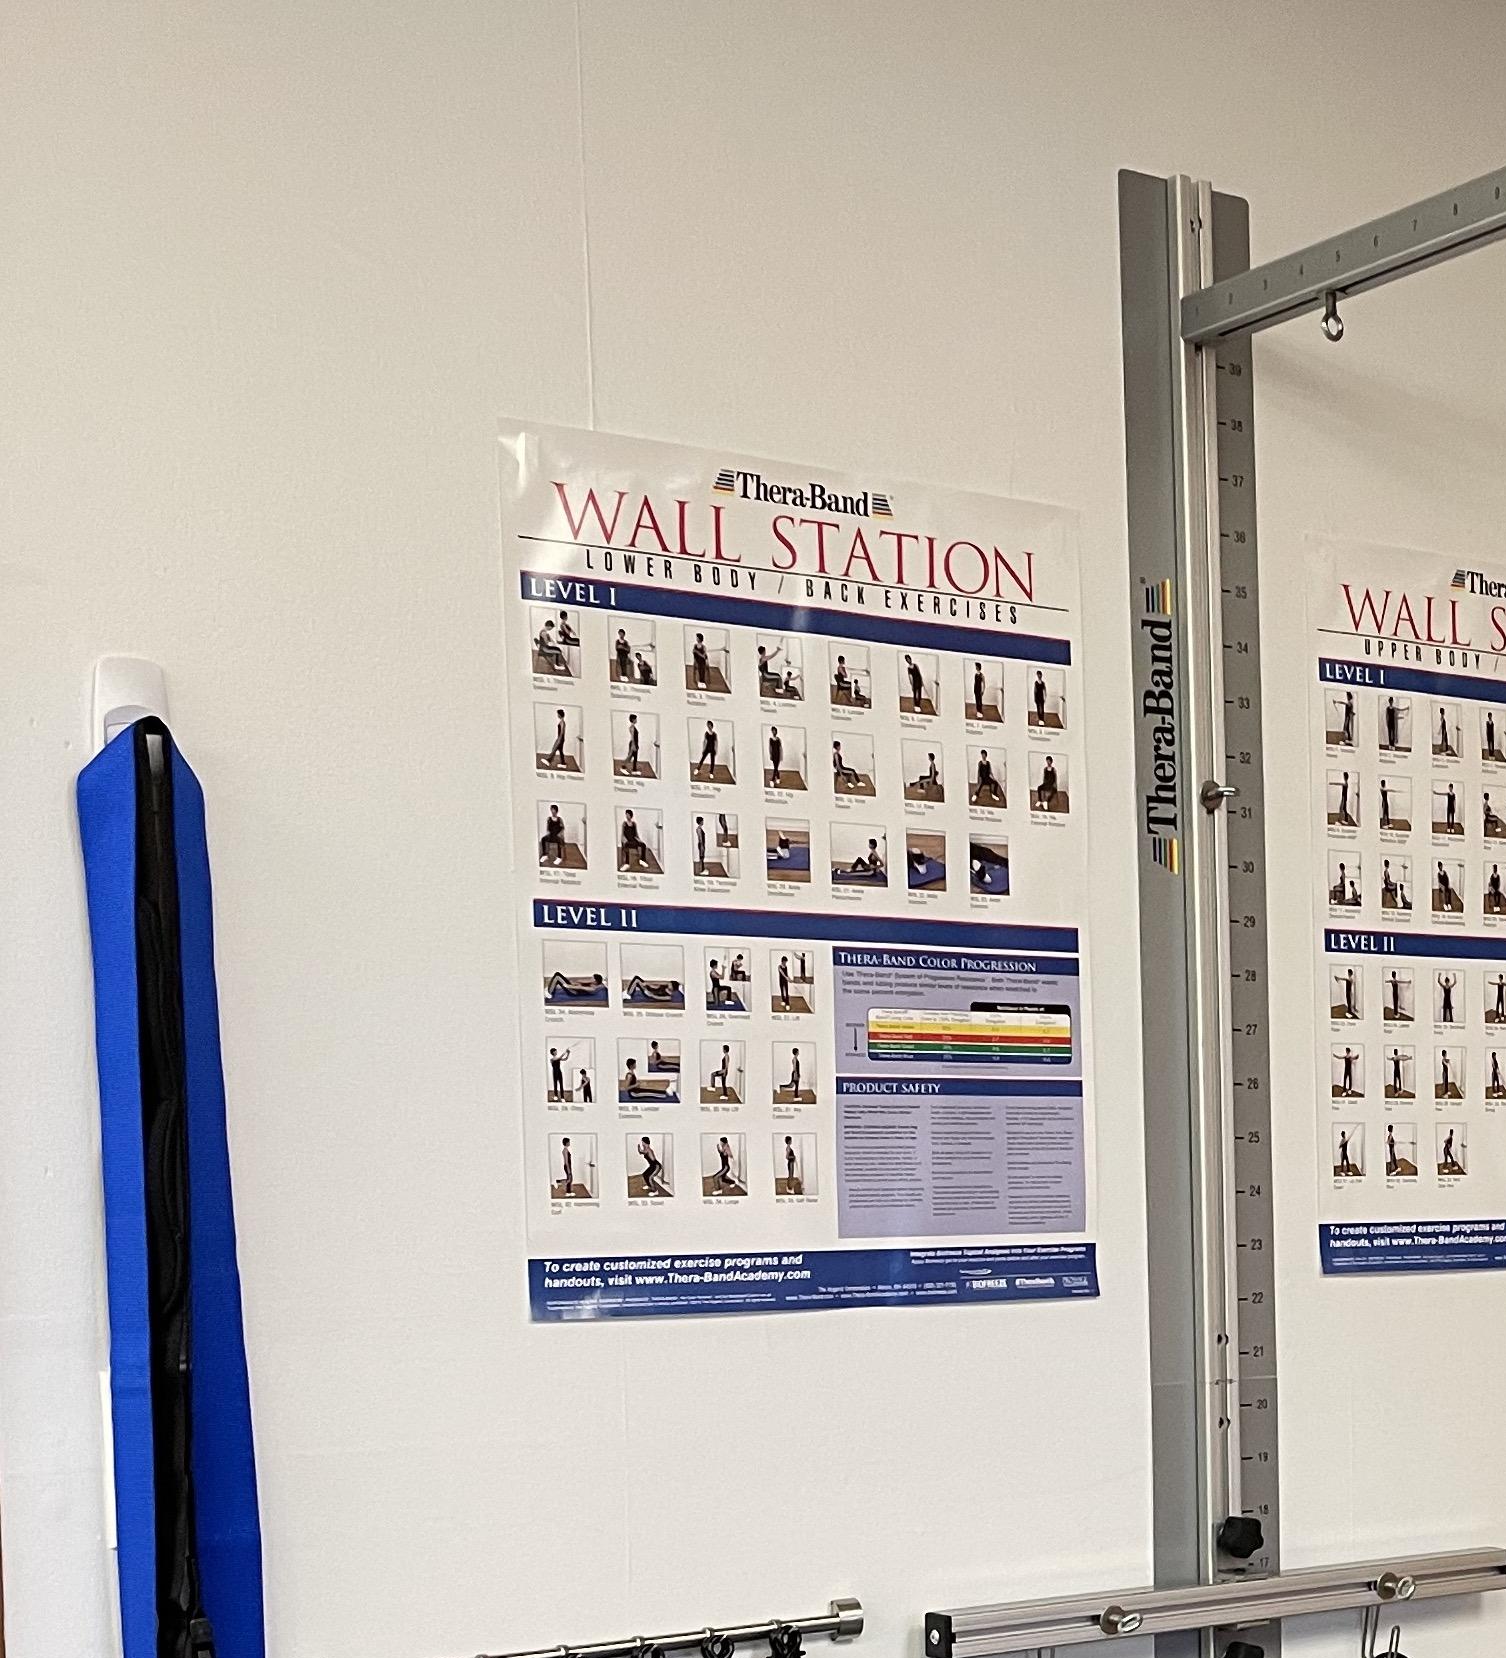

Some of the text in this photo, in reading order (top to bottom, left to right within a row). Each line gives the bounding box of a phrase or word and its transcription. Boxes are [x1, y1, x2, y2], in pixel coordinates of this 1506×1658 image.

[1231, 419, 1242, 432] 38
[1233, 475, 1244, 487] 37
[736, 470, 871, 518] Thera-Band
[550, 480, 1036, 603] WALL STATION
[530, 578, 617, 606] LEVEL I
[585, 549, 1018, 625] LOWER BODY / BACK EXERCISES
[1236, 586, 1247, 599] 35
[1340, 583, 1472, 647] WALL
[1237, 642, 1248, 653] 34
[1364, 638, 1422, 663] UPPER
[1435, 648, 1481, 671] BODY
[1325, 663, 1385, 685] LEVEL I
[1142, 619, 1178, 835] Thera-Band
[1240, 752, 1251, 764] 32
[1241, 807, 1251, 818] 31
[1243, 861, 1254, 873] 30
[543, 904, 637, 928] LEVEL II
[1244, 916, 1255, 928] 29
[1331, 933, 1395, 952] LEVEL II
[838, 952, 1038, 973] THERA-BAND COLOR PROGRESSION
[1245, 970, 1256, 981] 28
[1246, 1024, 1257, 1035] 27
[842, 1082, 941, 1094] PRODUCT SAFETY
[1248, 1078, 1258, 1089] 26
[1249, 1131, 1259, 1143] 25
[1250, 1185, 1260, 1196] 24
[1329, 1225, 1340, 1235] To
[1251, 1239, 1262, 1250] 23
[544, 1254, 803, 1273] To create customized exercise programs and
[544, 1275, 606, 1289] handouts,
[607, 1273, 633, 1287] visit
[1252, 1292, 1263, 1304] 22
[1253, 1346, 1263, 1357] 21
[1257, 1399, 1267, 1409] 20
[1258, 1452, 1268, 1462] 19
[1259, 1505, 1269, 1514] 18
[1260, 1557, 1269, 1568] 17
